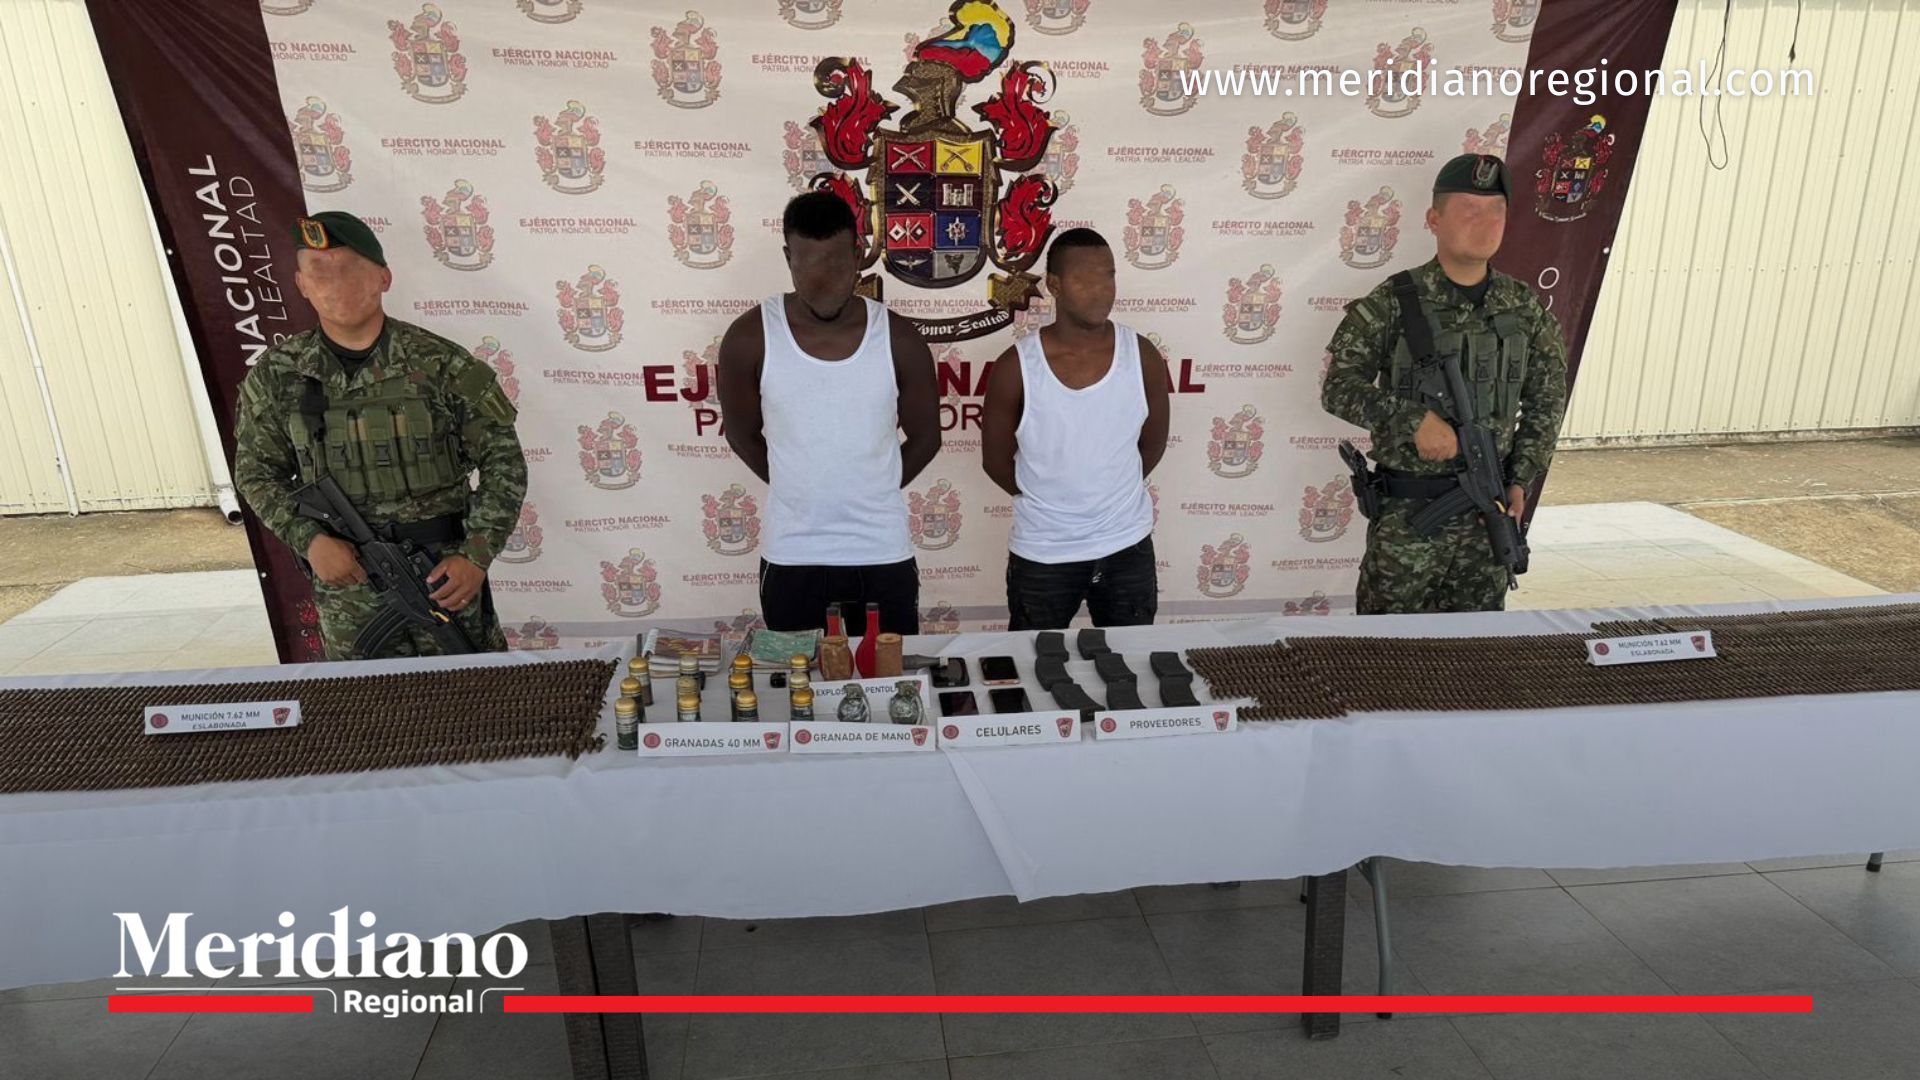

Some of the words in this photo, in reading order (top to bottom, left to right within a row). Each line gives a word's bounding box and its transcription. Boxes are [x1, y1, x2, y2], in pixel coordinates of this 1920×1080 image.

[290, 43, 357, 53] NACIONAL
[492, 47, 551, 60] EJÉRCITO
[555, 51, 618, 61] NACIONAL
[751, 53, 808, 65] EJÉRCITO
[504, 58, 534, 66] PATRIA
[1053, 61, 1110, 71] NACIONAL
[381, 136, 441, 148] EJÉRCITO
[444, 139, 506, 149] NACIONAL
[634, 139, 690, 151] EJÉRCITO
[693, 143, 752, 151] NACIONAL
[392, 148, 423, 156] PATRIA
[1107, 146, 1159, 156] EJÉRCITO
[1161, 147, 1215, 156] NACIONAL
[1331, 148, 1381, 158] EJÉRCITO
[1384, 150, 1435, 159] NACIONAL
[361, 217, 393, 226] ONAL
[519, 217, 576, 228] EJÉRCITO
[579, 218, 638, 227] NACIONAL
[1052, 220, 1096, 229] ACIONAL
[1212, 220, 1261, 229] EJÉRCITO
[1264, 221, 1315, 230] NACIONAL
[229, 175, 288, 321] LEALTAD
[188, 154, 268, 366] NACIONAL
[413, 299, 470, 311] EJÉRCITO
[472, 301, 530, 311] NACIONAL
[651, 298, 704, 308] EJÉRCITO
[888, 298, 931, 307] JÉRCITO
[934, 299, 986, 307] NACIONAL
[1114, 298, 1144, 306] RCITO
[1147, 298, 1197, 306] NACIONAL
[1195, 363, 1242, 372] EJÉRCITO
[1244, 364, 1294, 372] NACIONAL
[543, 368, 596, 379] EJÉRCITO
[1290, 436, 1337, 444] EJÉRCITO
[523, 447, 553, 456] ONAL
[667, 444, 718, 454] EJÉRCITO
[1181, 503, 1226, 511] EJÉRCITO
[565, 518, 616, 527] EJÉRCITO
[618, 515, 671, 524] NACIONAL
[521, 580, 573, 588] NACIONAL
[865, 686, 896, 694] PENTOL
[181, 711, 225, 721] MUNICIÓN
[226, 711, 242, 719] 7.62
[192, 721, 247, 730] ESLABONADA
[1130, 717, 1202, 729] PROVEEDORES
[976, 725, 1042, 738] CELULARES
[813, 733, 863, 742] GRANADA
[865, 732, 879, 741] DE
[881, 732, 911, 741] MANO
[664, 738, 724, 748] GRANADAS
[727, 738, 741, 748] 40
[743, 738, 760, 748] MM
